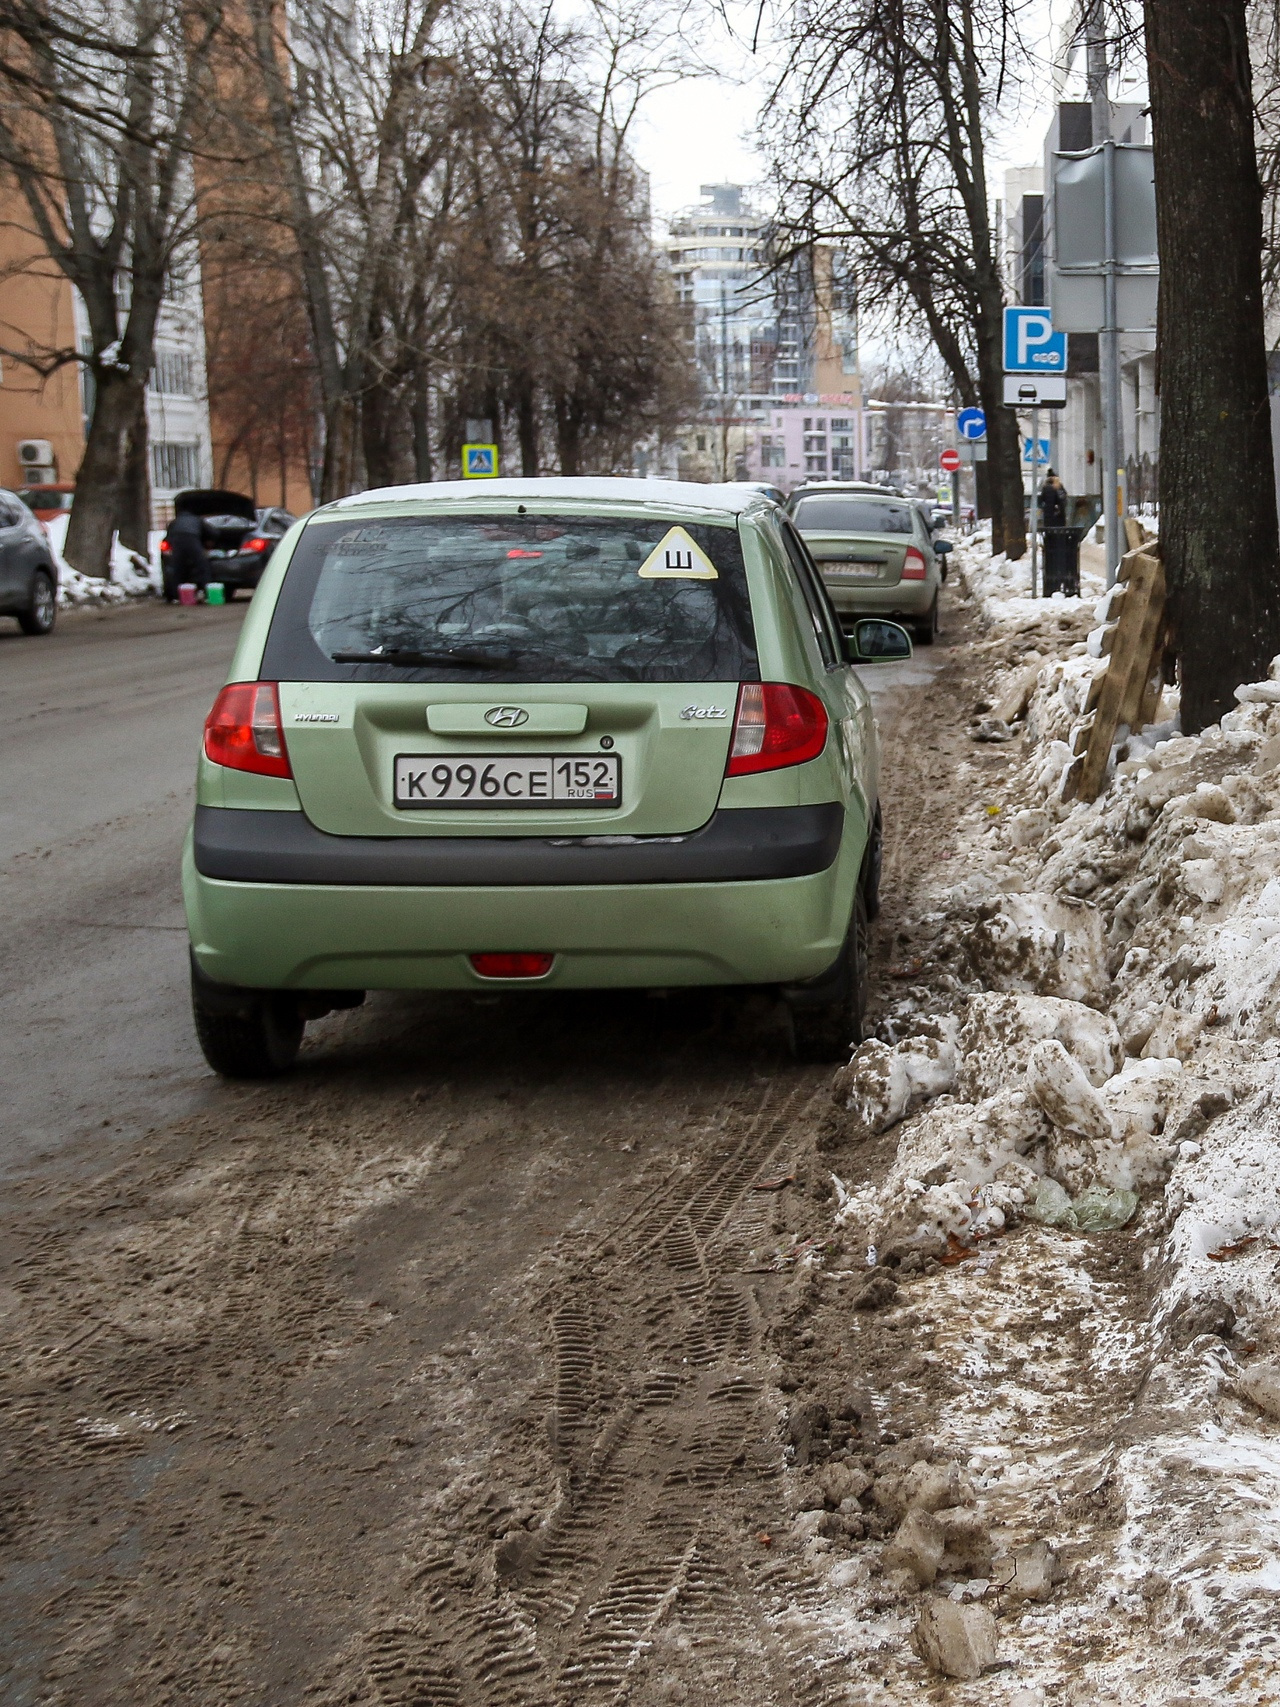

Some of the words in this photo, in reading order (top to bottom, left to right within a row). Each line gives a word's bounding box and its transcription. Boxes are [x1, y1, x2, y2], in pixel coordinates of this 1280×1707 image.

[1018, 315, 1052, 364] P
[666, 551, 692, 569] Ш
[295, 713, 339, 722] HYUNDAI
[680, 705, 726, 720] Getz
[557, 762, 609, 788] 152
[568, 789, 593, 797] RUS
